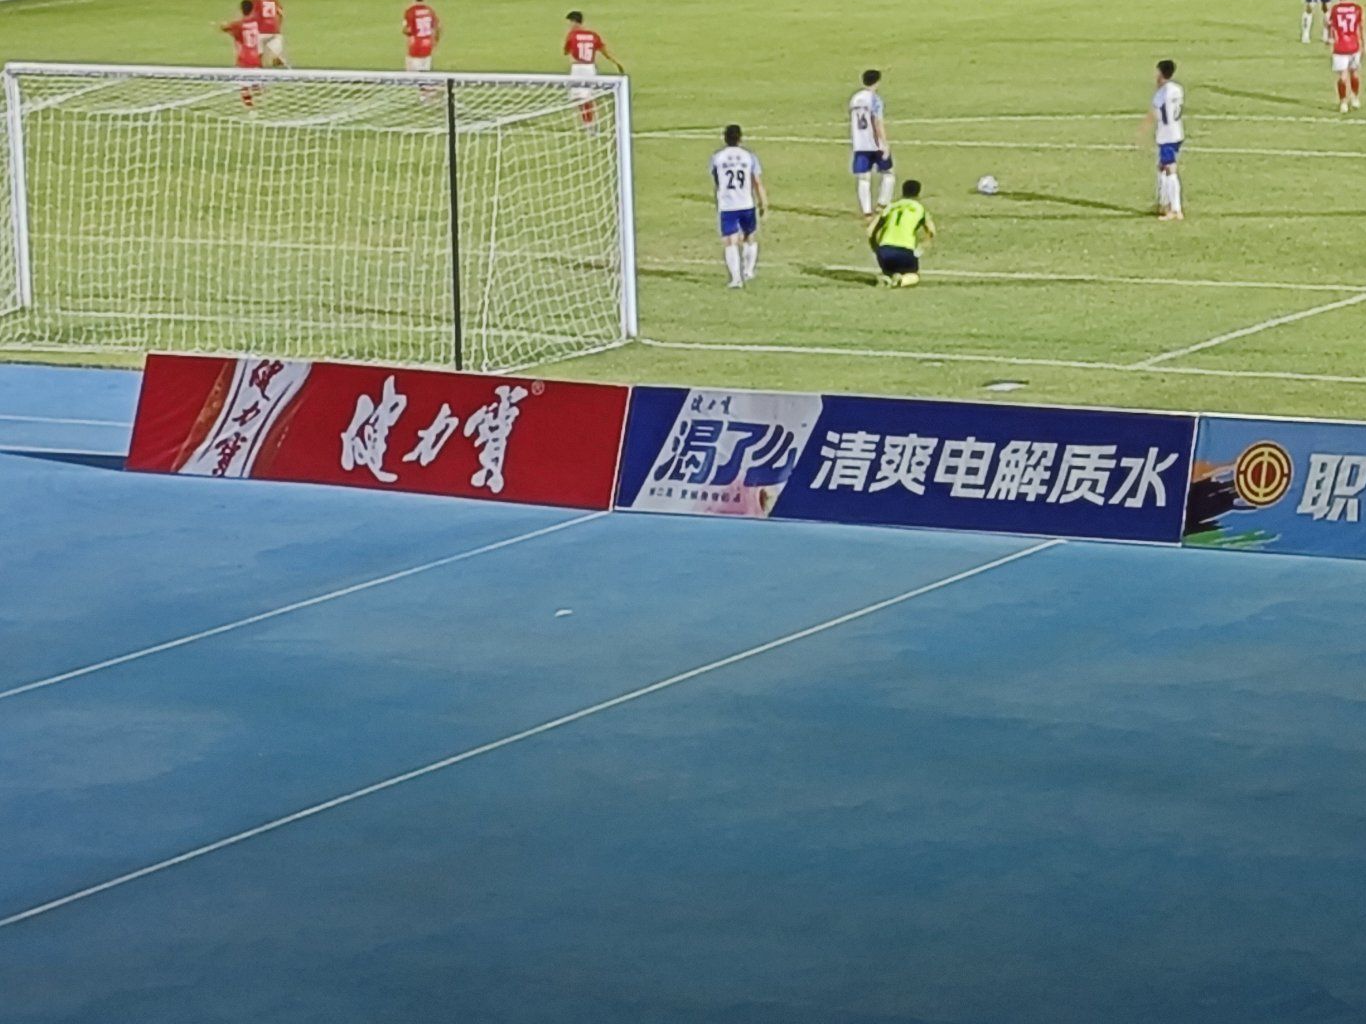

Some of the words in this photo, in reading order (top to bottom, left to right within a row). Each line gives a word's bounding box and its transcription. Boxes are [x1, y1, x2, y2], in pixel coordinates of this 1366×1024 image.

[1337, 13, 1356, 33] 47
[725, 169, 746, 190] 29
[809, 429, 1181, 509] 清爽电解质水
